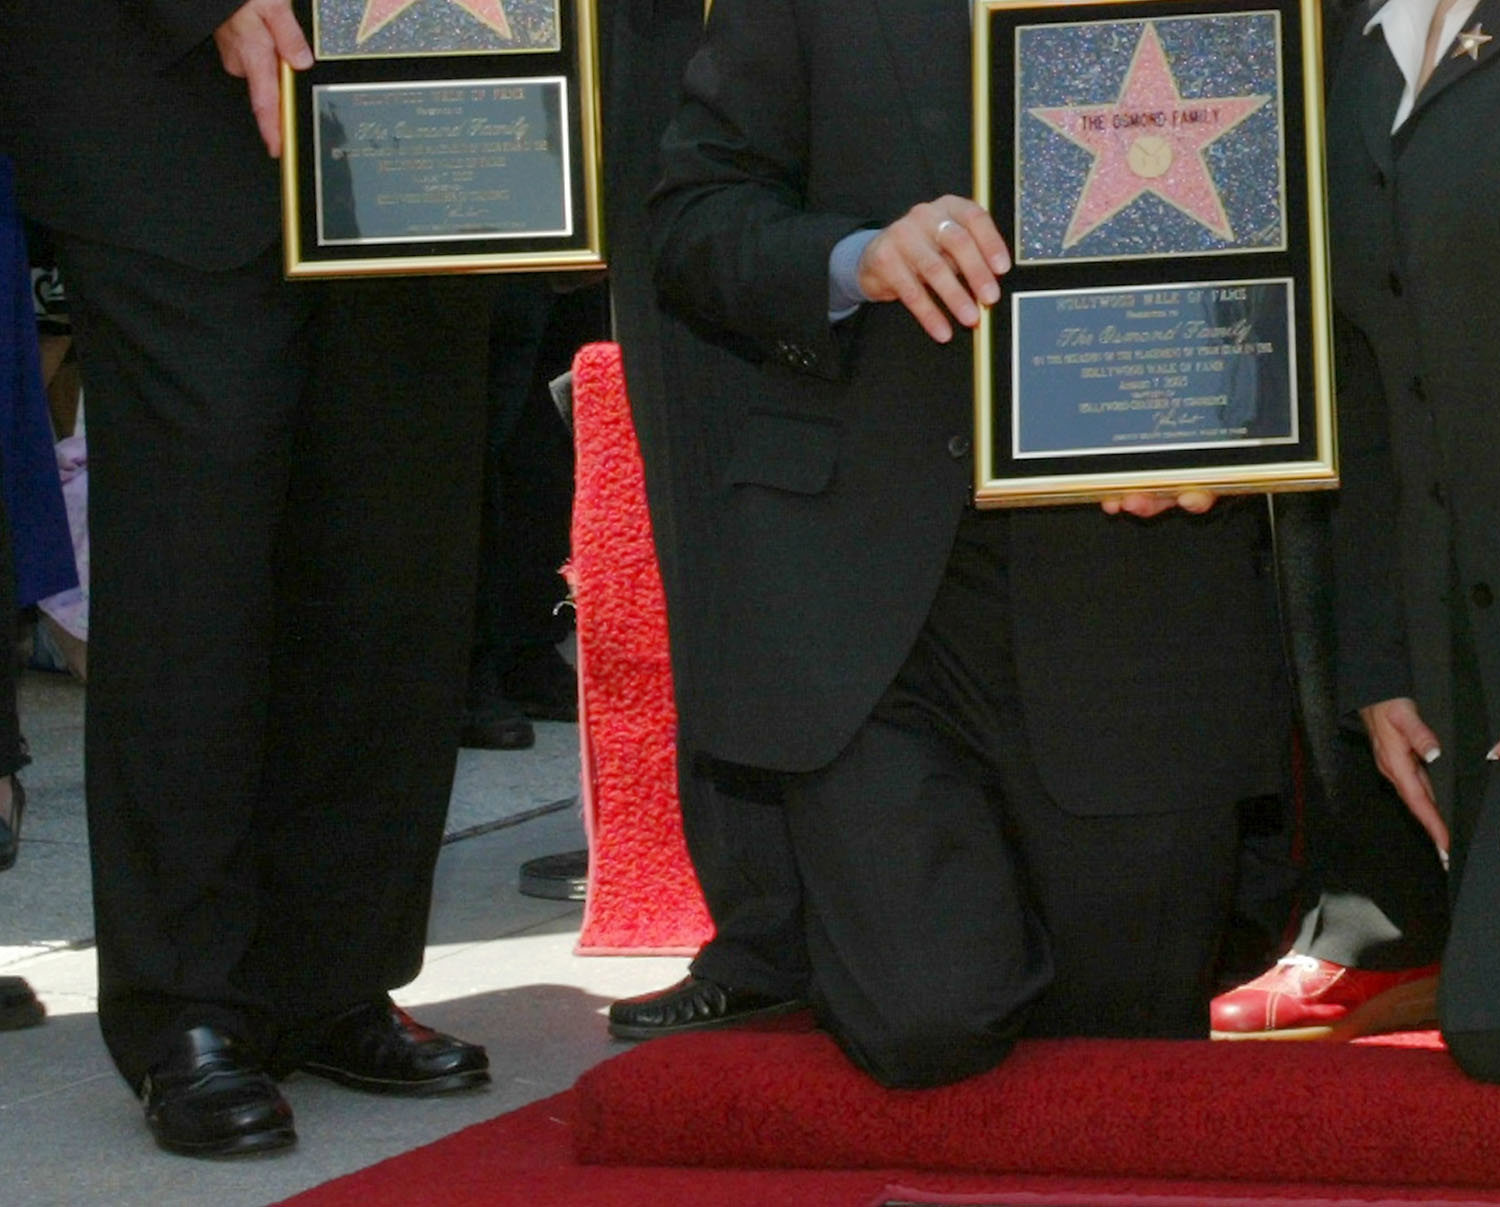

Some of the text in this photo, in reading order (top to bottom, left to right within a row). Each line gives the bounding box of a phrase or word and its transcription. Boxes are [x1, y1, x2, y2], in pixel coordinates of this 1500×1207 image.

[1082, 108, 1220, 131] THE OSMOND FAMILY
[1055, 294, 1135, 311] HOLLYWOOD
[1143, 291, 1180, 306] WALK
[1211, 288, 1247, 303] FAME
[1056, 319, 1252, 347] The Osmond Family
[1080, 365, 1145, 379] HOLLYWOOD
[1146, 362, 1177, 375] WALK
[1195, 360, 1224, 372] FAME
